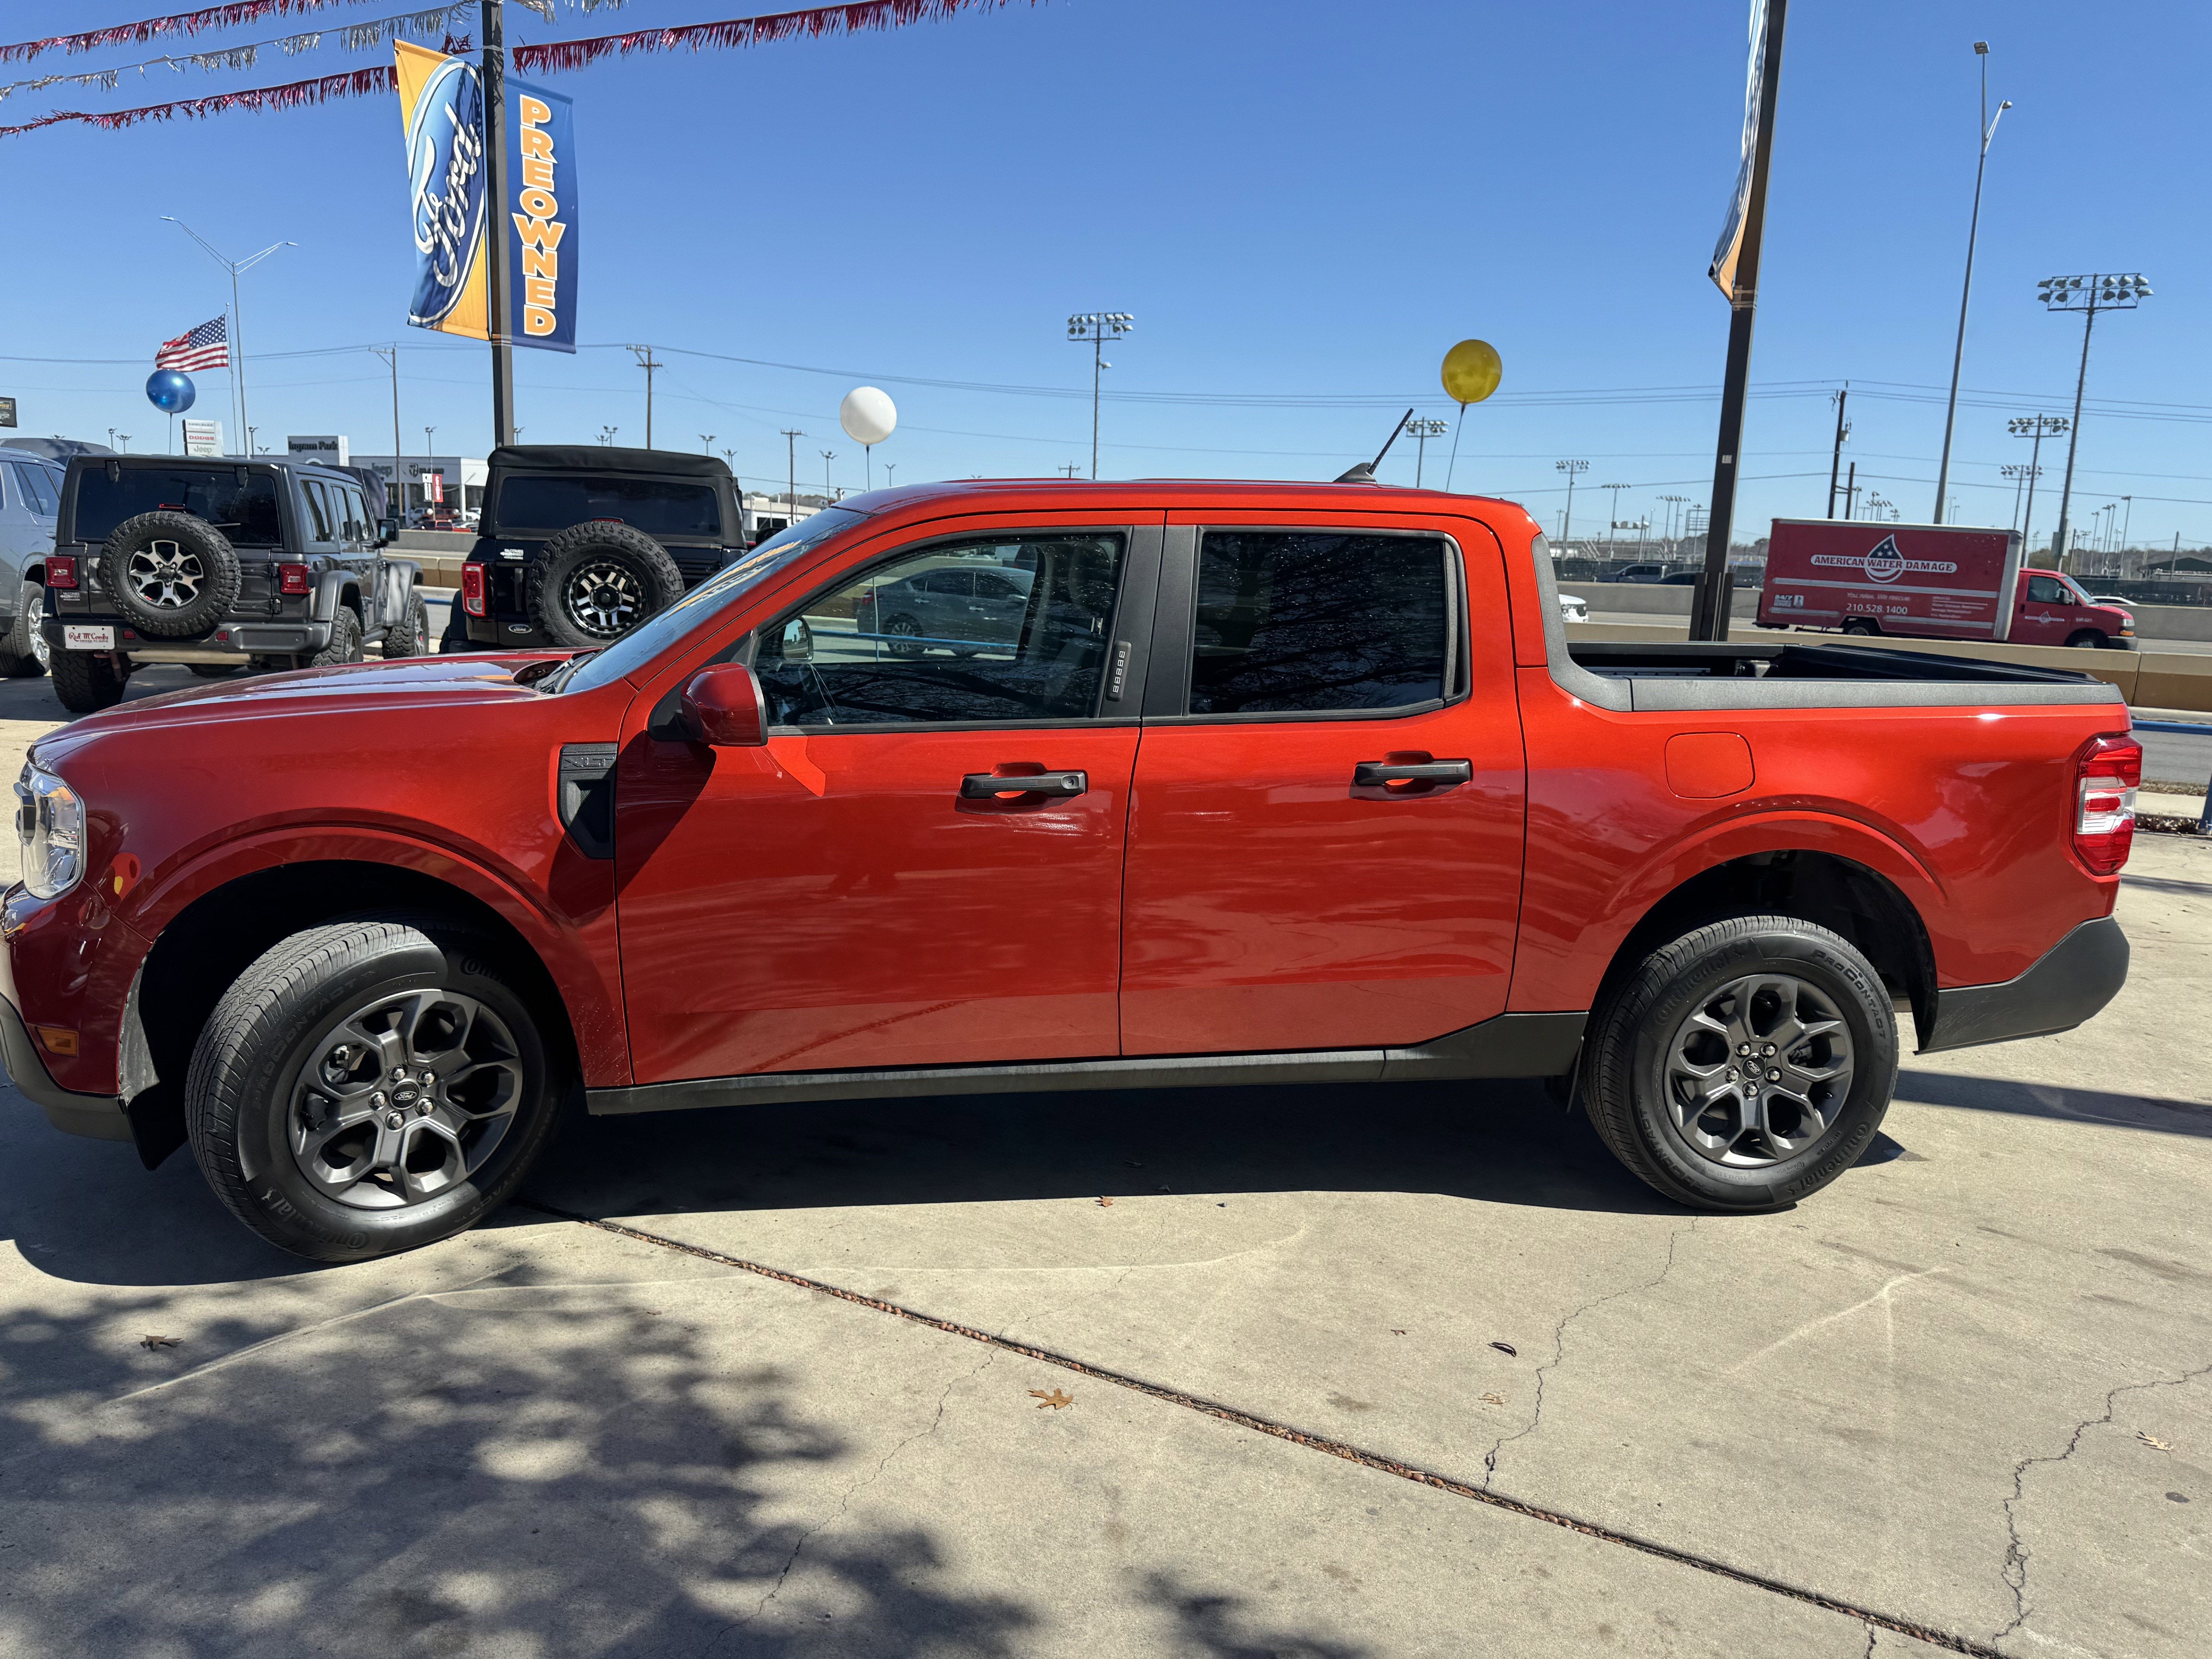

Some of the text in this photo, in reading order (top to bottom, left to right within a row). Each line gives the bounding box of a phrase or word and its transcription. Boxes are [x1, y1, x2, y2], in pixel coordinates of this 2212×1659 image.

[413, 101, 481, 287] Ford
[512, 94, 566, 336] PREOWNED
[194, 445, 212, 453] Jeep
[288, 441, 338, 452] Ingram Park
[1814, 556, 1953, 572] AMERICAN WATER DAMAGE
[1846, 603, 1908, 615] 210.528.1400
[564, 757, 615, 768] XLT
